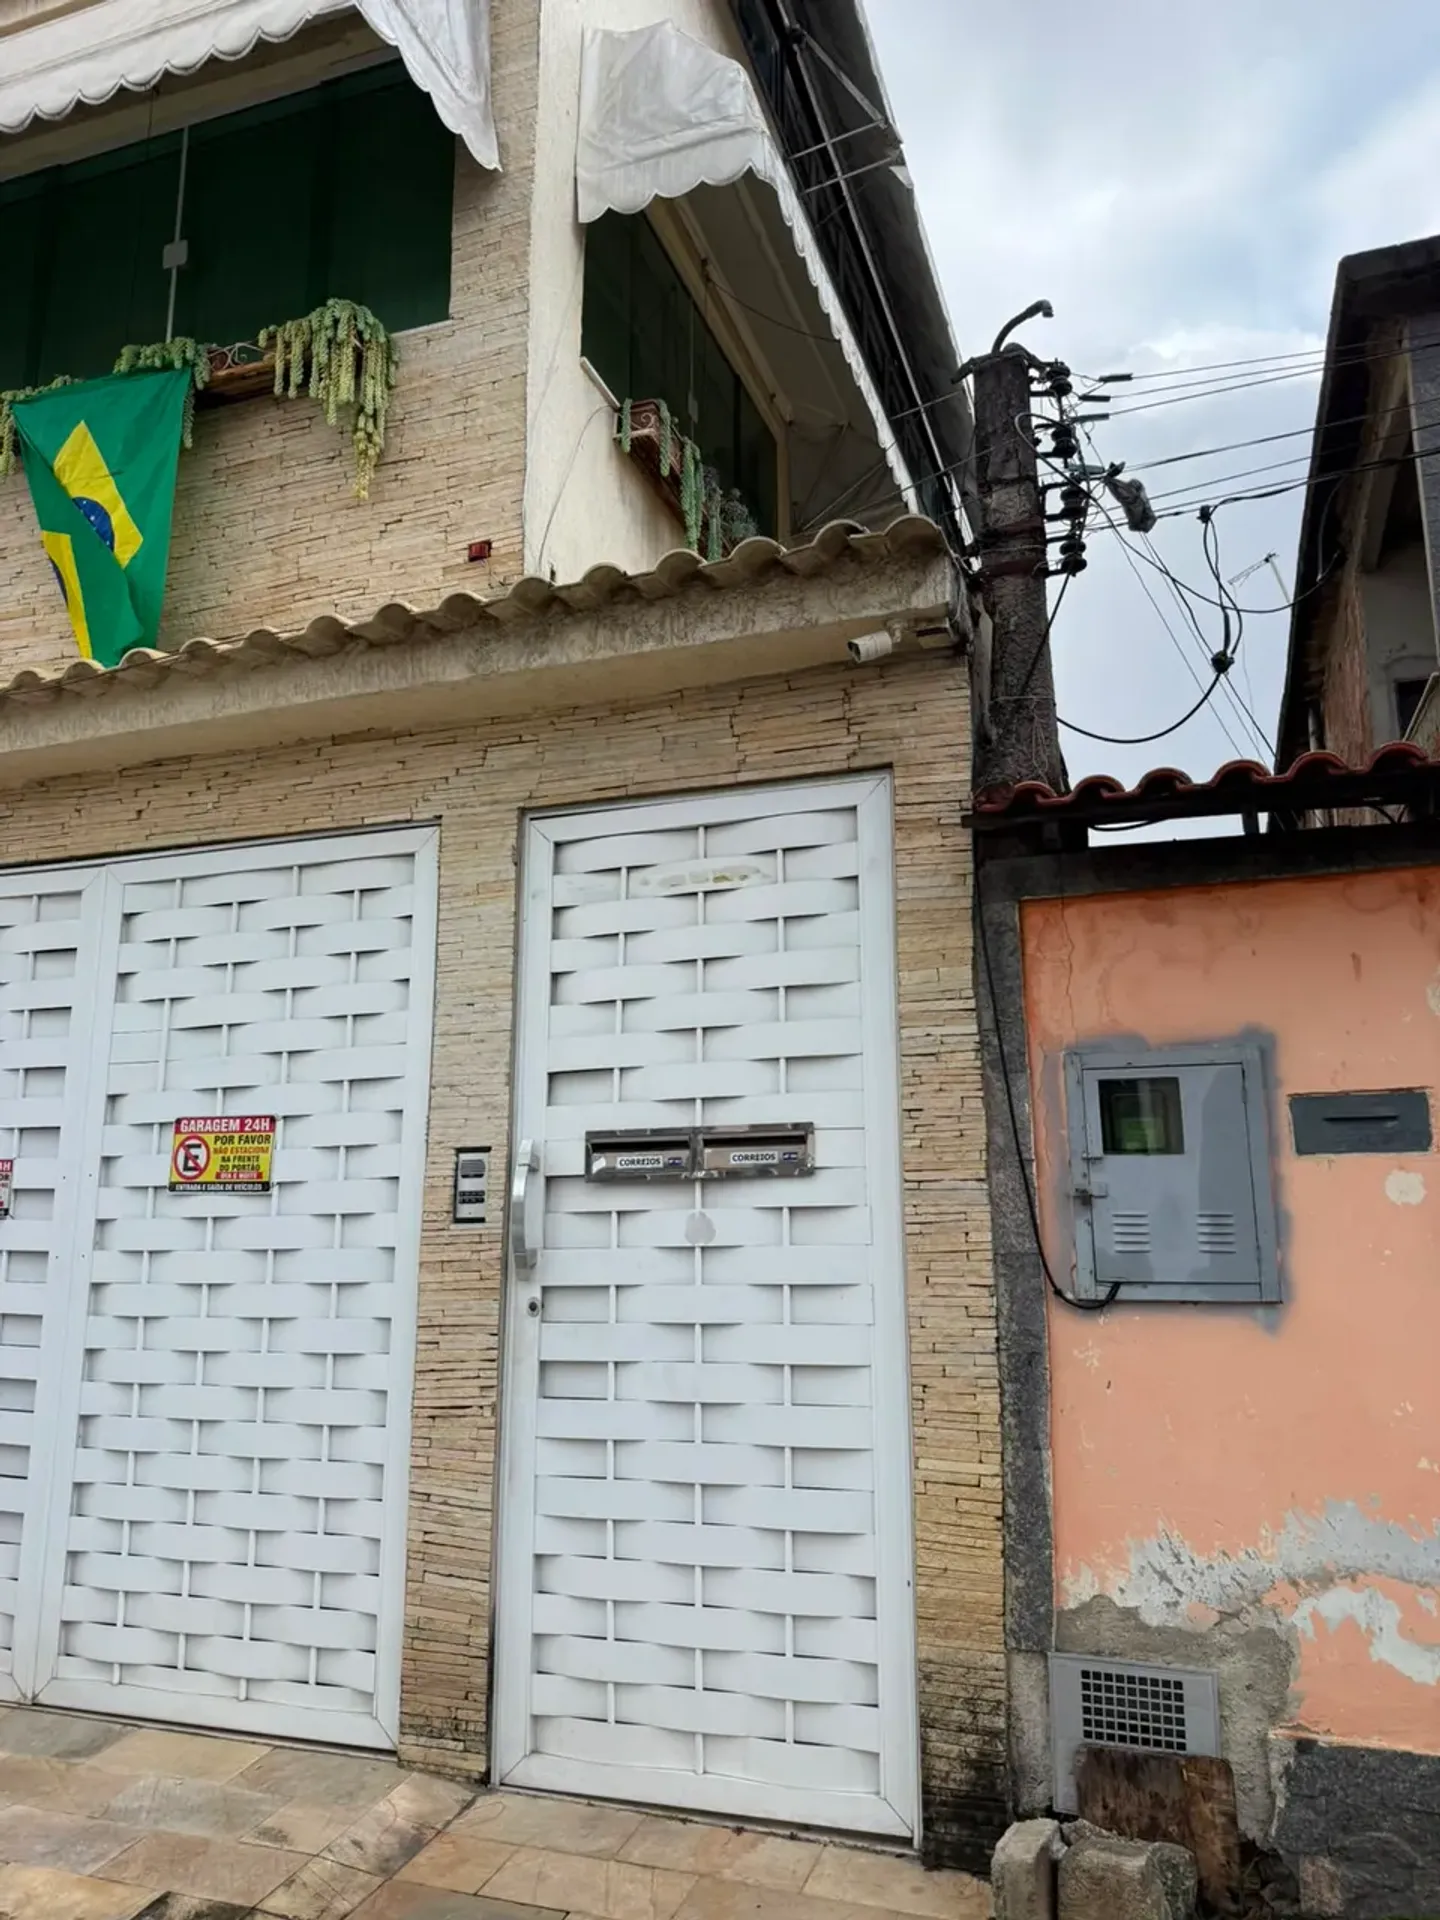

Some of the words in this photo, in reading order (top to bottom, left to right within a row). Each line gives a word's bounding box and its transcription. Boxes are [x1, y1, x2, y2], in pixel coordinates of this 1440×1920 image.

[180, 1119, 240, 1132] GARAGEM
[244, 1117, 270, 1131] 24H
[214, 1135, 235, 1145] POR
[238, 1134, 271, 1145] FAVOR
[619, 1157, 661, 1167] CORREIOS
[731, 1153, 776, 1162] CORREIOS
